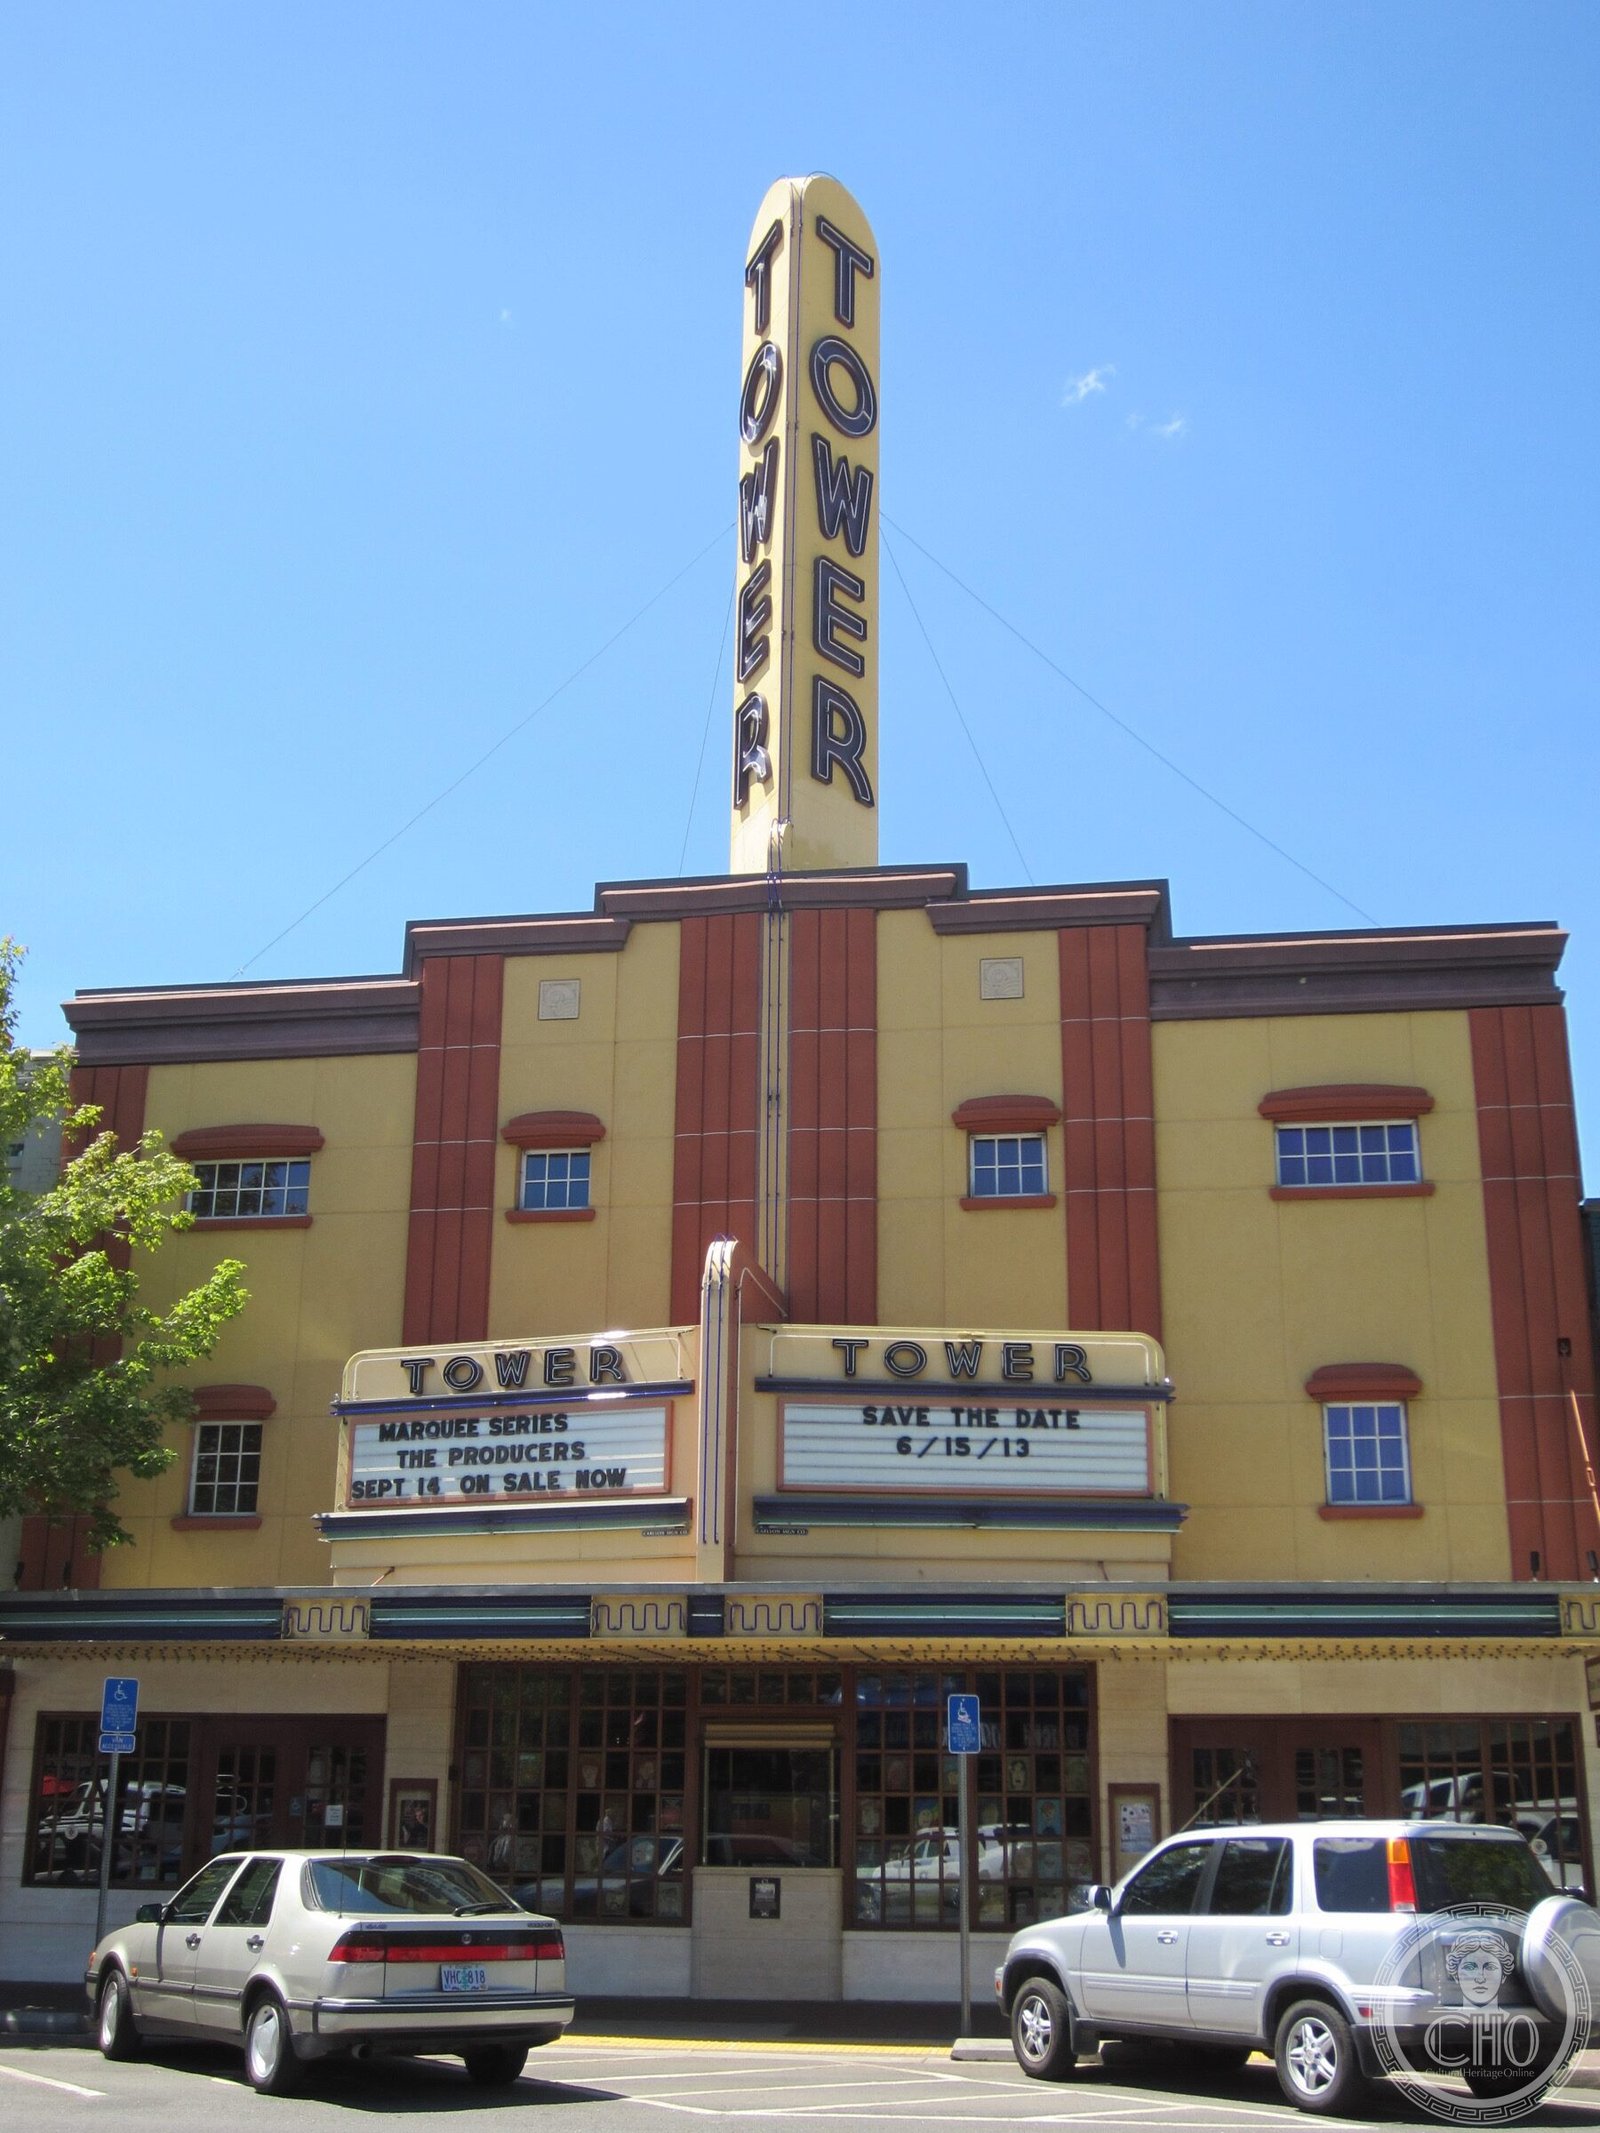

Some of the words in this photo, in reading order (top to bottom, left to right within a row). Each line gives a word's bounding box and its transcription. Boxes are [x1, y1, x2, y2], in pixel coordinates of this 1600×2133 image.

[734, 218, 783, 810] TOWER
[809, 214, 877, 808] TOWER
[400, 1344, 626, 1394] TOWER
[832, 1338, 1092, 1382] TOWER
[379, 1417, 480, 1442] MARQUEE
[489, 1413, 569, 1437] SERIES
[862, 1406, 930, 1427] SAVE
[951, 1408, 999, 1428] THE
[1015, 1409, 1080, 1430] DATE
[397, 1449, 437, 1469] THE
[449, 1441, 585, 1467] PRODUCERS
[896, 1436, 1030, 1459] 6/15/13
[352, 1478, 405, 1499] SEPT
[418, 1476, 440, 1496] 14
[460, 1473, 490, 1494] ON
[503, 1470, 560, 1492] SALE
[575, 1467, 627, 1488] NOW
[443, 1970, 462, 1984] VHC
[467, 1970, 486, 1984] 818
